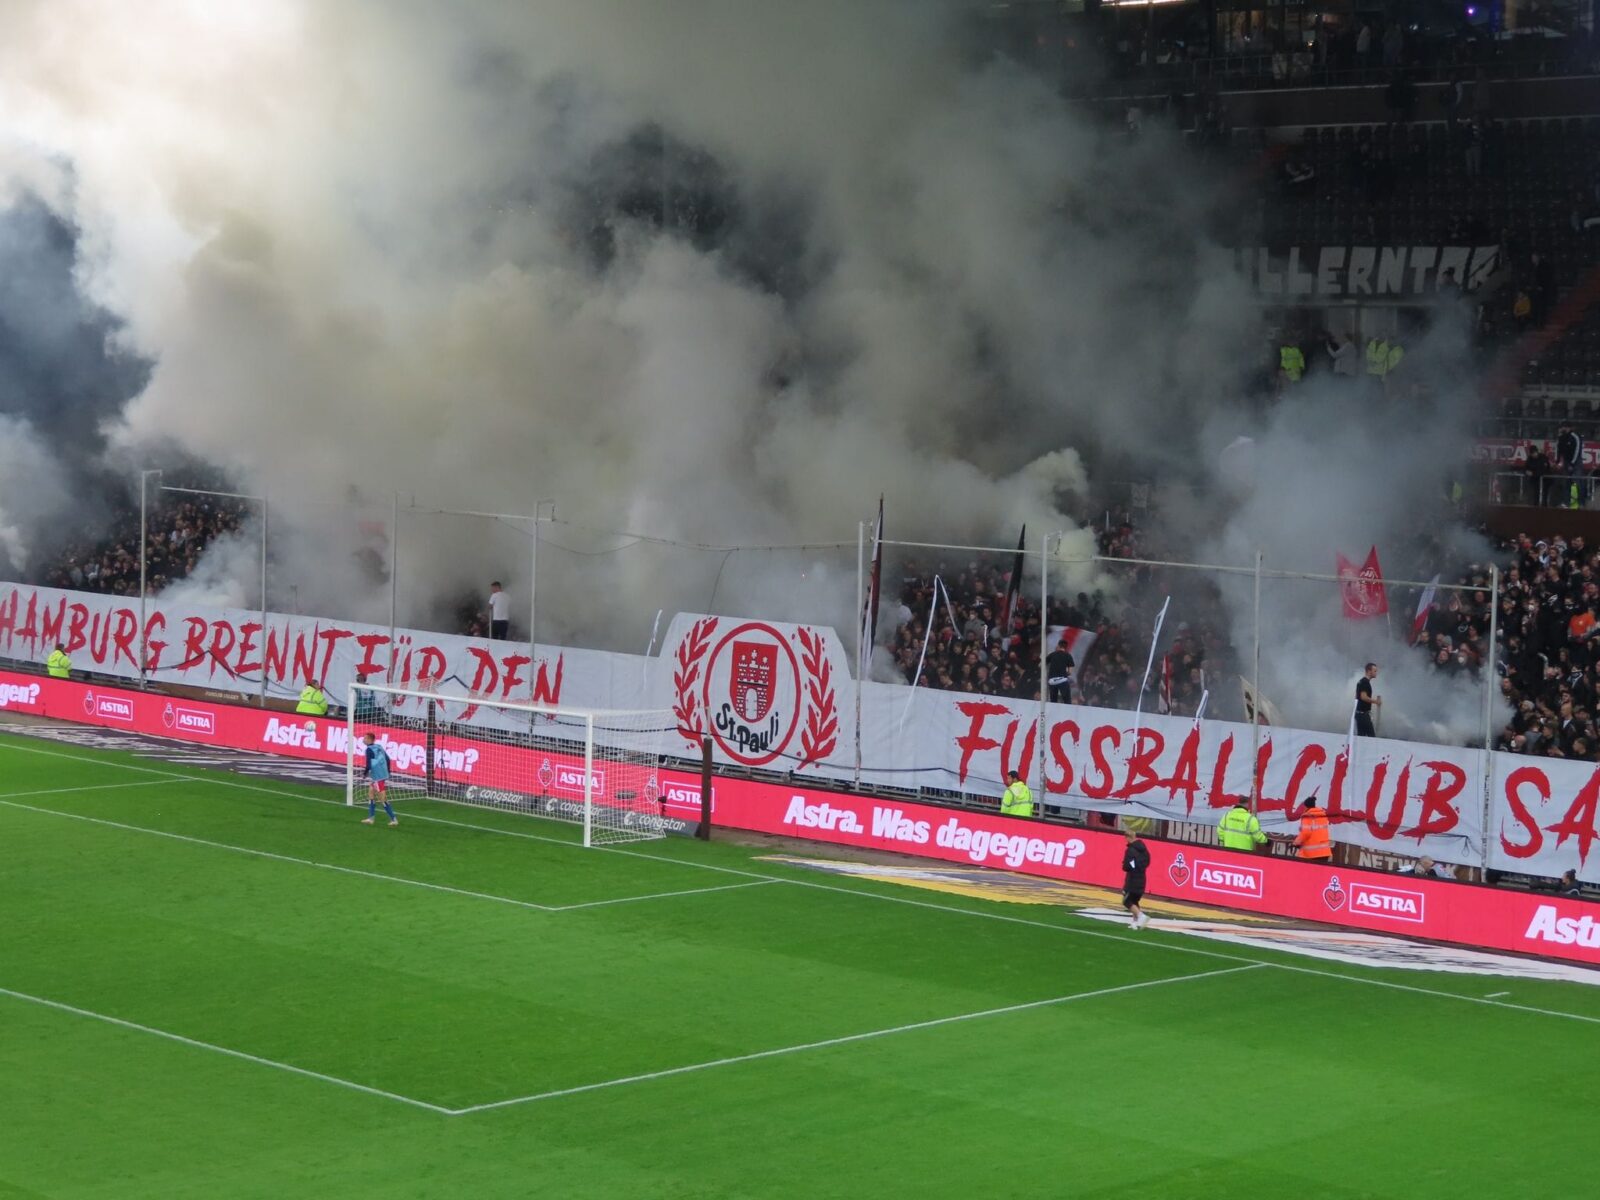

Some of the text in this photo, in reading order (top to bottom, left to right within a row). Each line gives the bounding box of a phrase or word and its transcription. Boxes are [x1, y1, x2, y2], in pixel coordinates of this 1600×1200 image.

[1214, 245, 1499, 294] ILLERNTOR
[0, 587, 563, 721] HAMBURG BRENNT FÜR DEN
[100, 701, 129, 715] ASTRA
[179, 714, 211, 728] ASTRA
[716, 703, 779, 753] St. Pauli
[263, 718, 321, 749] Astra.
[480, 789, 523, 804] congstar
[667, 789, 703, 804] ASTR
[954, 700, 1600, 872] FUSSBALLCLUB SA
[560, 801, 602, 815] congsar
[639, 815, 685, 831] congstar
[784, 796, 1086, 868] Astra. Was dagegen?
[1200, 868, 1256, 890] ASTRA
[1356, 892, 1417, 914] ASTRA
